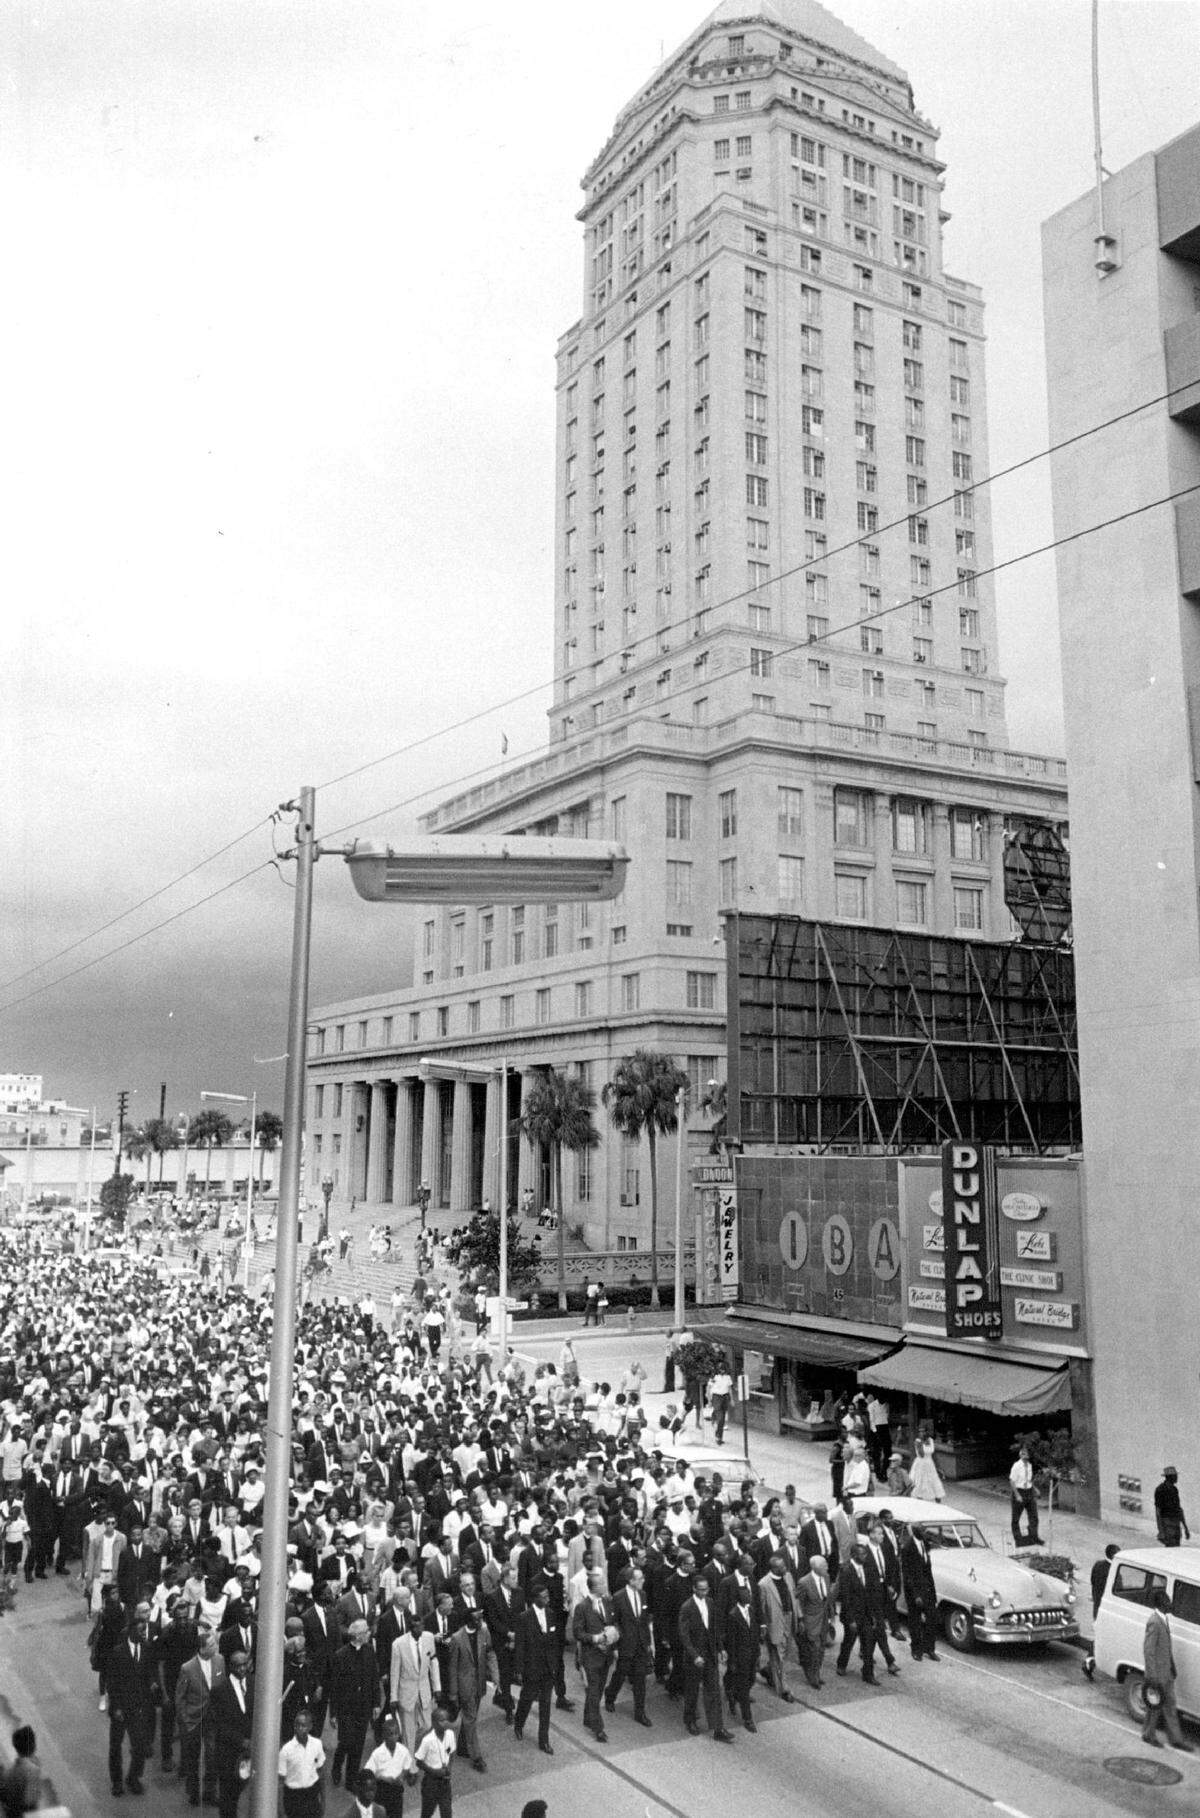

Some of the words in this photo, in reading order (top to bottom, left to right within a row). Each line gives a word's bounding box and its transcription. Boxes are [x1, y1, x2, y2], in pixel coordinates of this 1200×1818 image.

[722, 1196, 734, 1274] JEWELRY
[953, 1146, 983, 1307] DUNLAP
[955, 1311, 1001, 1327] SHOES
[1016, 1301, 1045, 1316] Natural
